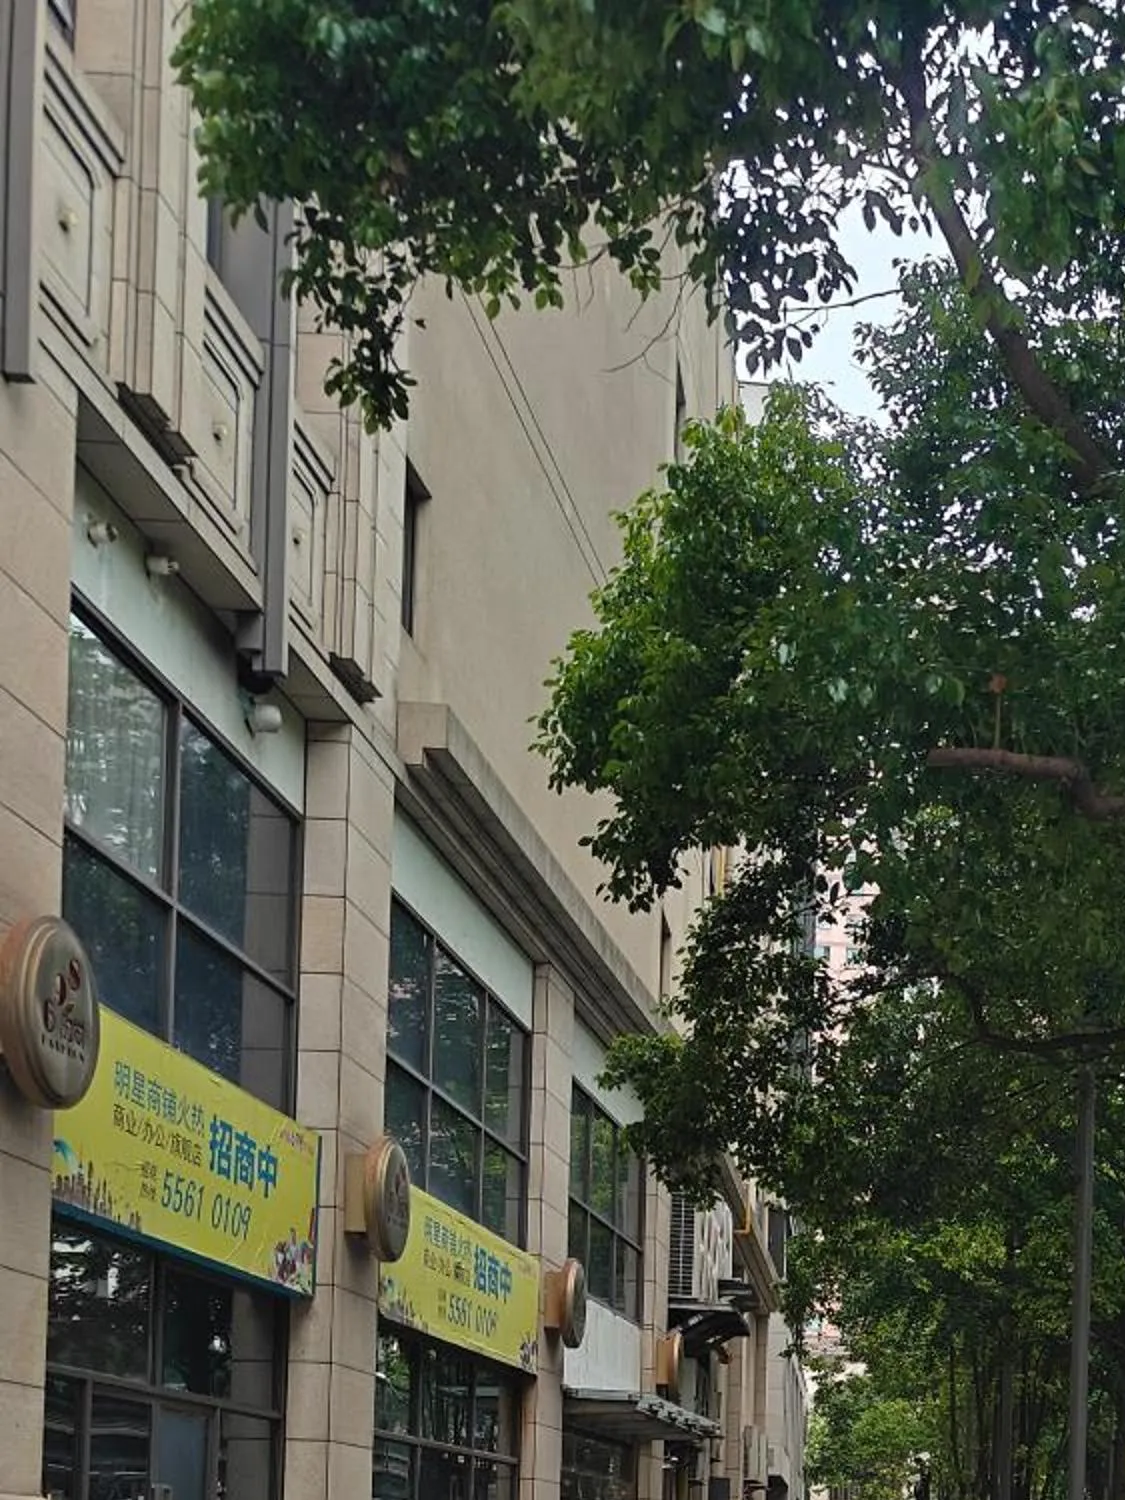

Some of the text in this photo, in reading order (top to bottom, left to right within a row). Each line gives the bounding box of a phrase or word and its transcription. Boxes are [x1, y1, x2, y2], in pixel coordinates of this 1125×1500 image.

[209, 1113, 278, 1199] 招商中
[161, 1168, 205, 1222] 5561
[211, 1194, 252, 1240] 0109
